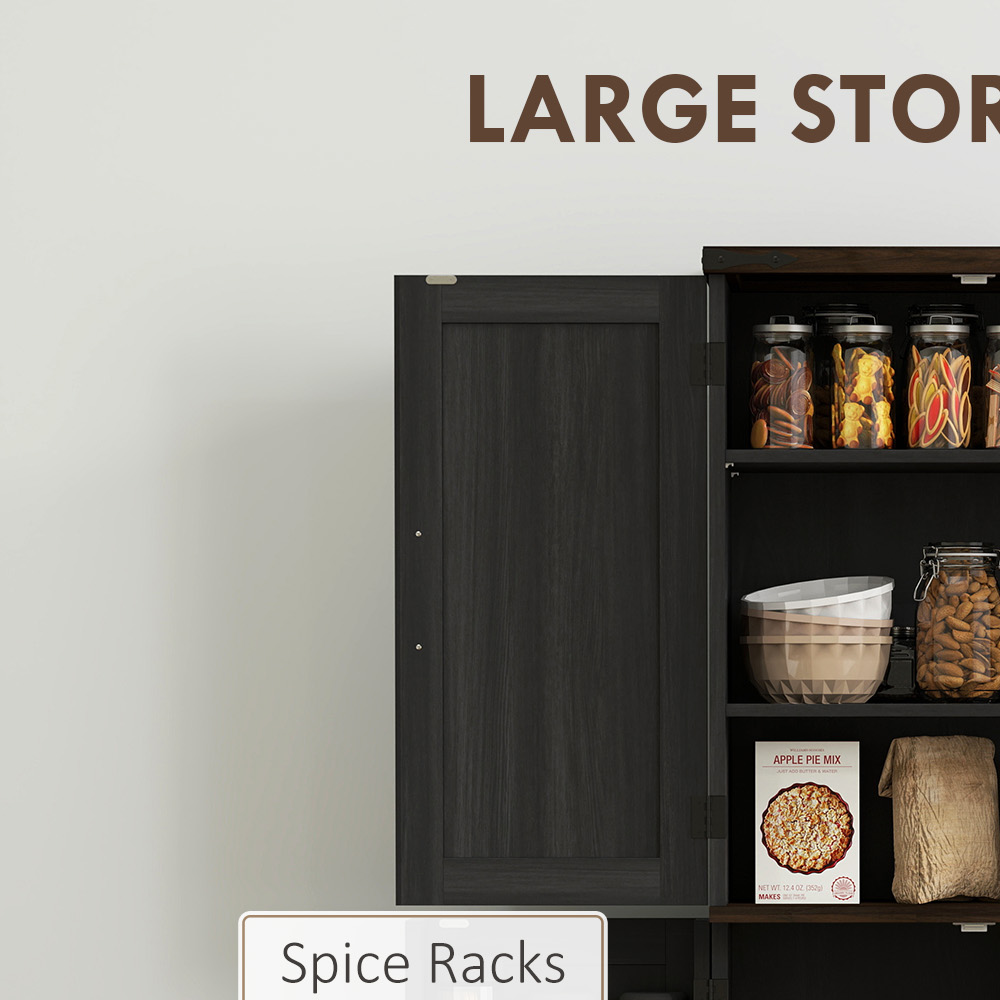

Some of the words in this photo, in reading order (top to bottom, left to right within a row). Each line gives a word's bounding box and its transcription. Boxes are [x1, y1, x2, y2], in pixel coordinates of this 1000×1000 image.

[774, 755, 803, 764] APPLE
[806, 755, 820, 764] PIE
[824, 755, 841, 764] MIX
